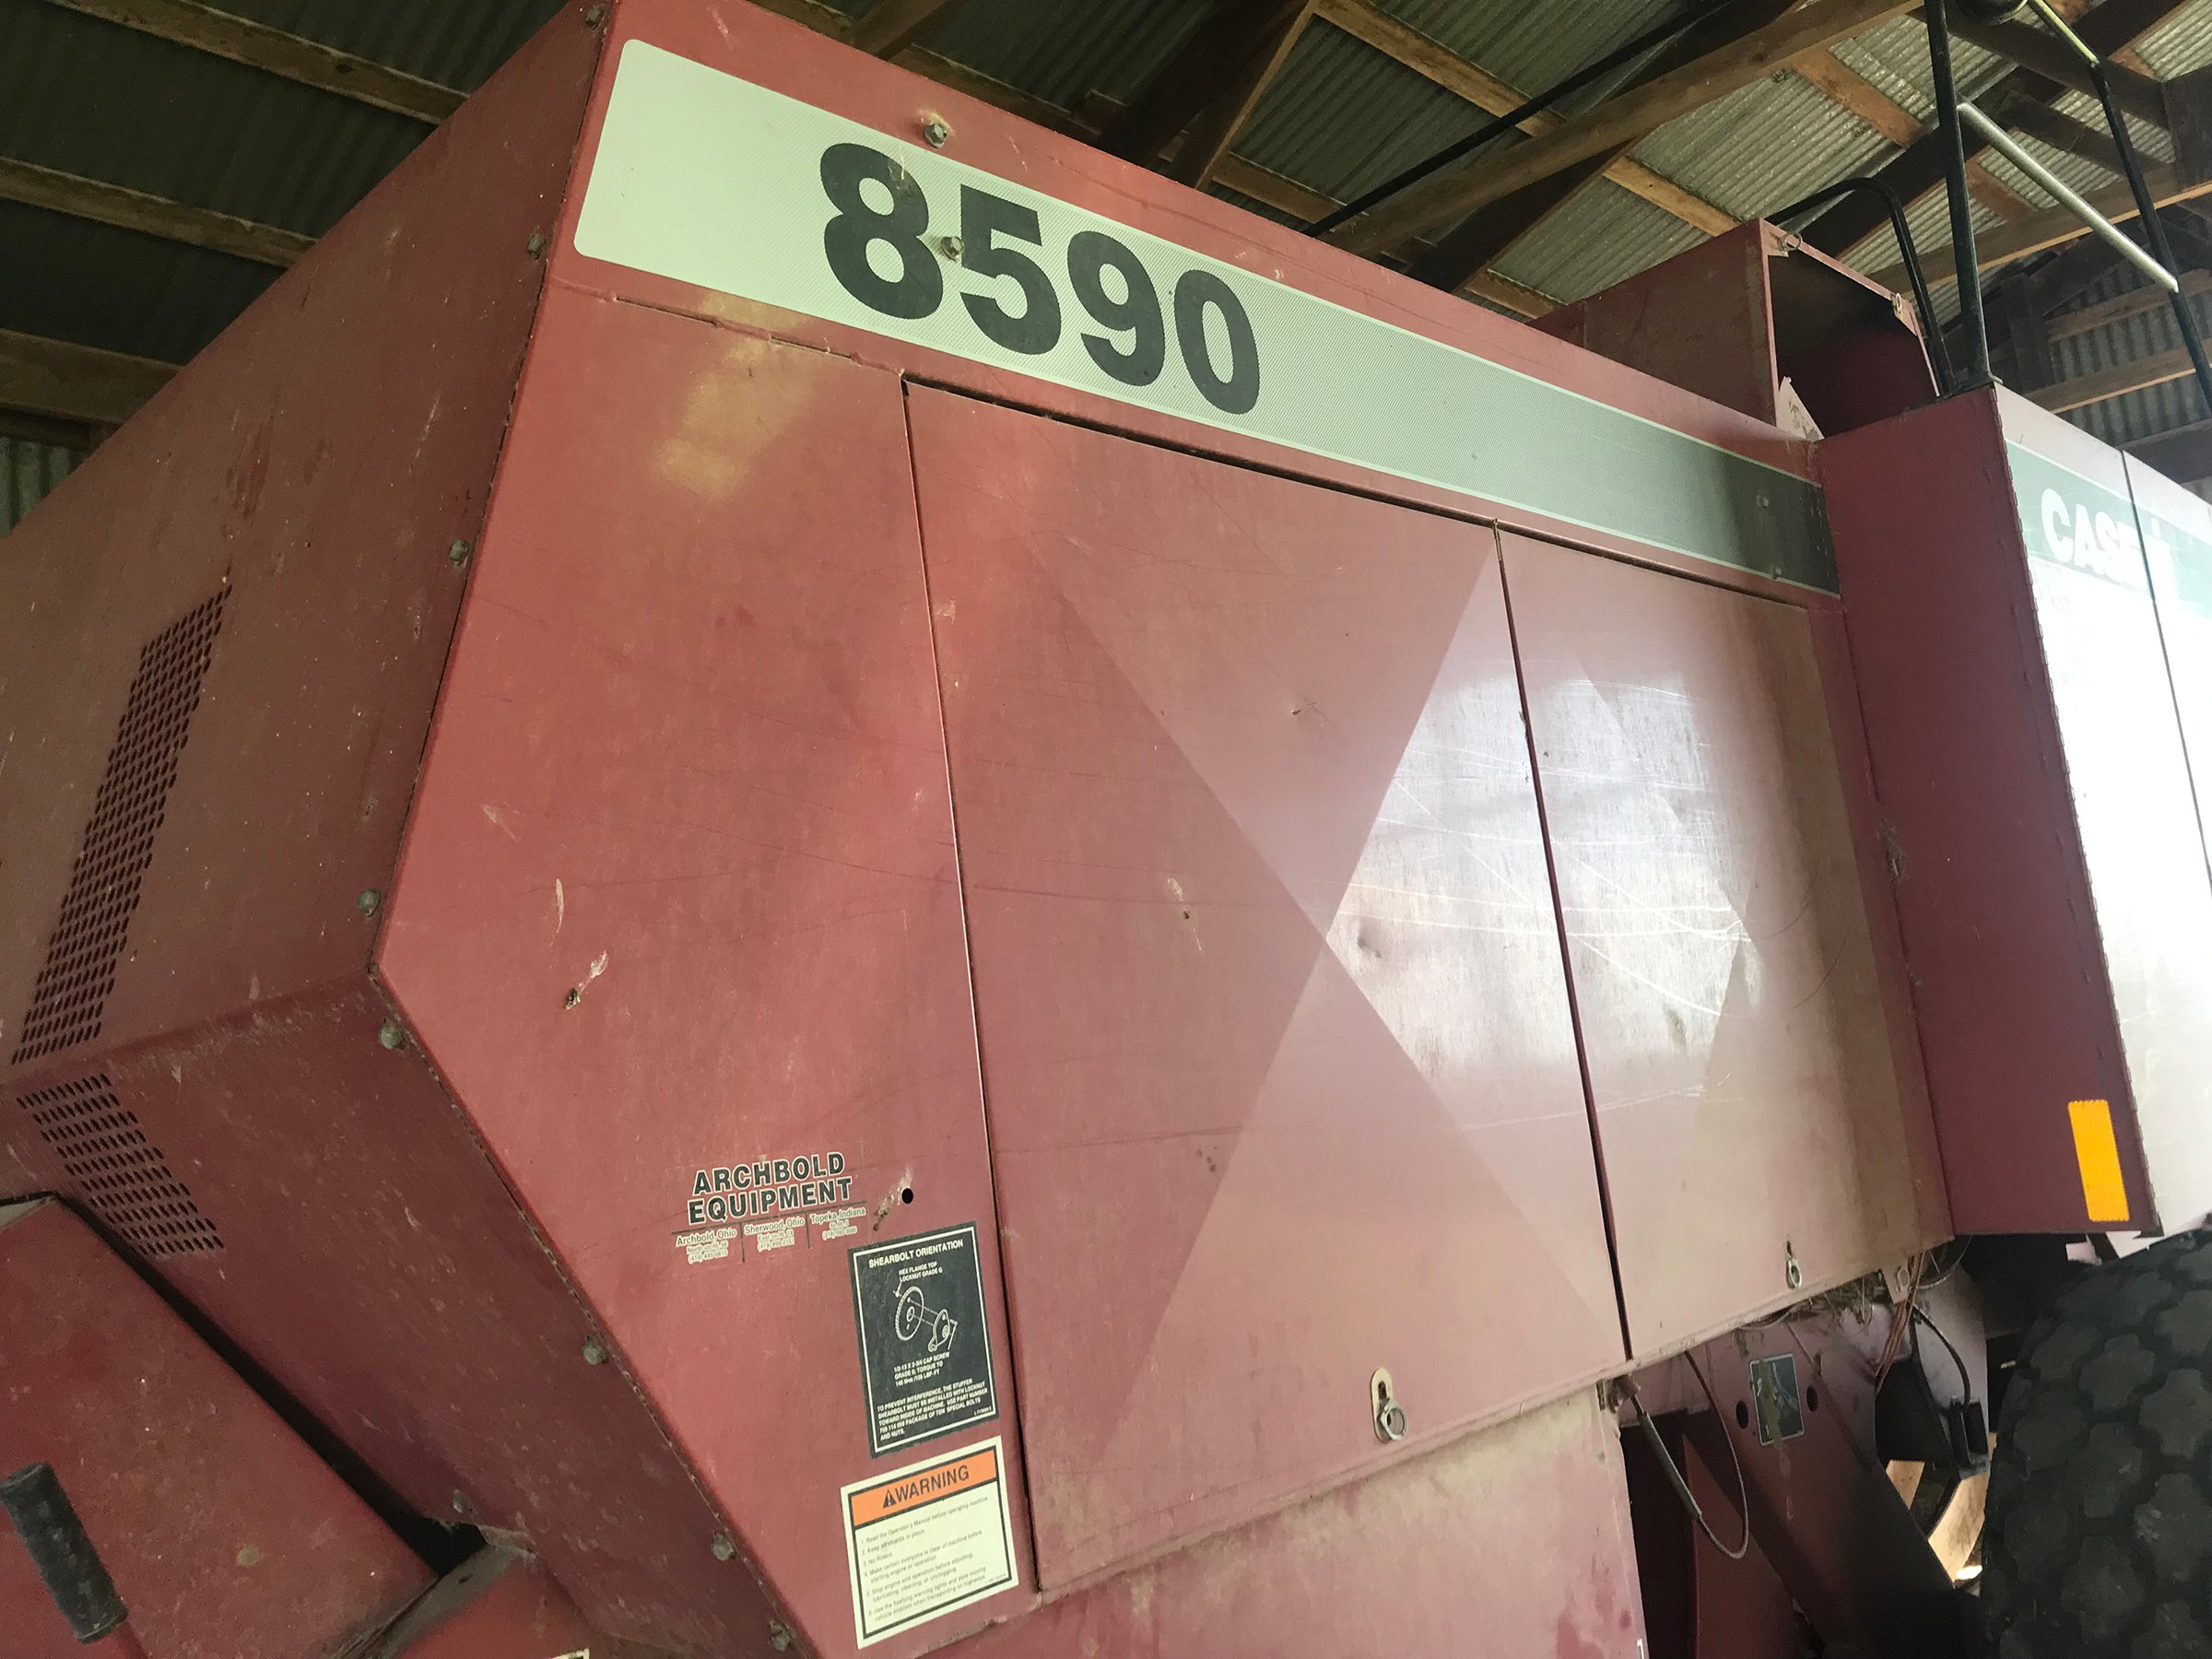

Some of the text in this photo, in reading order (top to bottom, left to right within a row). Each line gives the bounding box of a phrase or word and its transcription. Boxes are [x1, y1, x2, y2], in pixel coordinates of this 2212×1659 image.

[820, 143, 1260, 414] 8590
[692, 1151, 845, 1195] ARCHBOLD
[688, 1177, 853, 1225] EQUIPMENT
[836, 1206, 866, 1220] Indiana
[784, 1217, 806, 1231] Ohio
[716, 1227, 738, 1241] Ohio
[868, 1239, 963, 1268] SHEARBOLT ORIENTATION
[885, 1398, 906, 1410] PREVENT
[877, 1406, 906, 1419] SHEARBOLT
[878, 1415, 900, 1427] TOWARD
[880, 1432, 891, 1441] AND
[894, 1464, 970, 1504] WARNING
